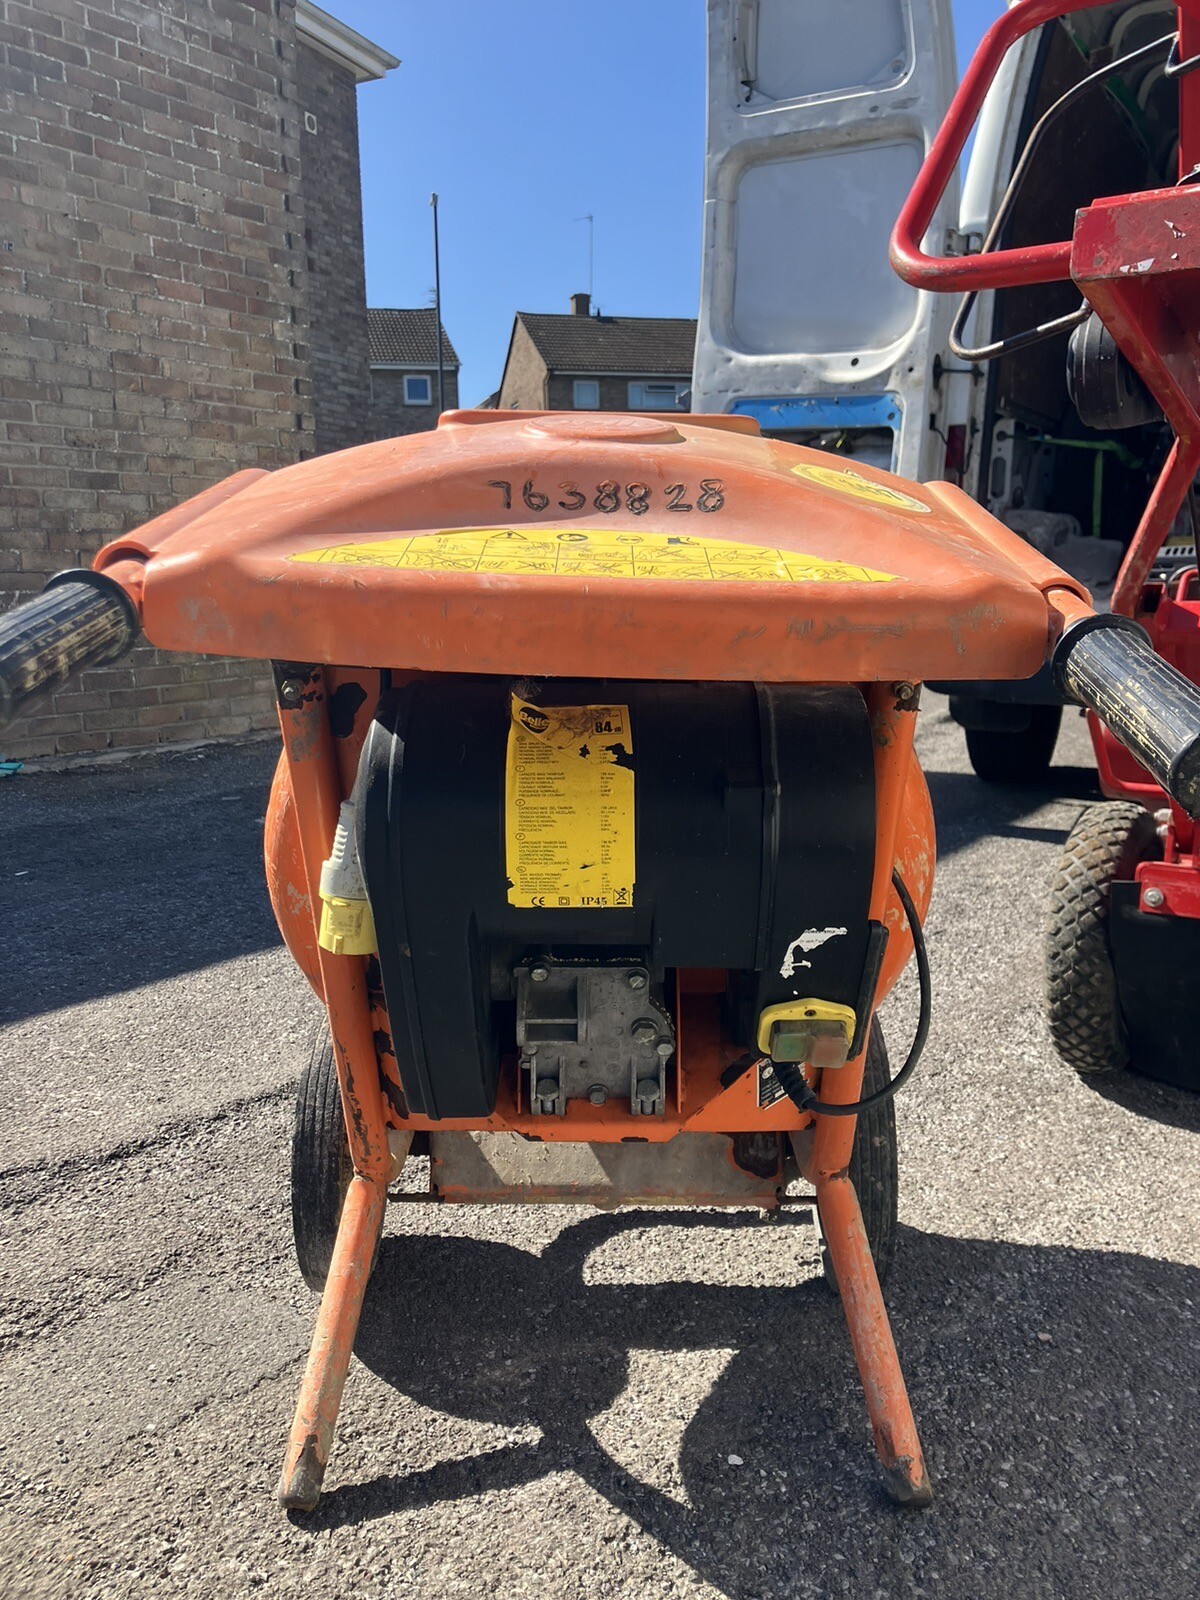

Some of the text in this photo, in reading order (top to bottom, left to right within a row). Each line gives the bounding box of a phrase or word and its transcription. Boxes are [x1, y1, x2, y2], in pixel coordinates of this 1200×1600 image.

[519, 710, 549, 728] Belle
[595, 721, 613, 733] 84
[581, 896, 608, 906] IP45
